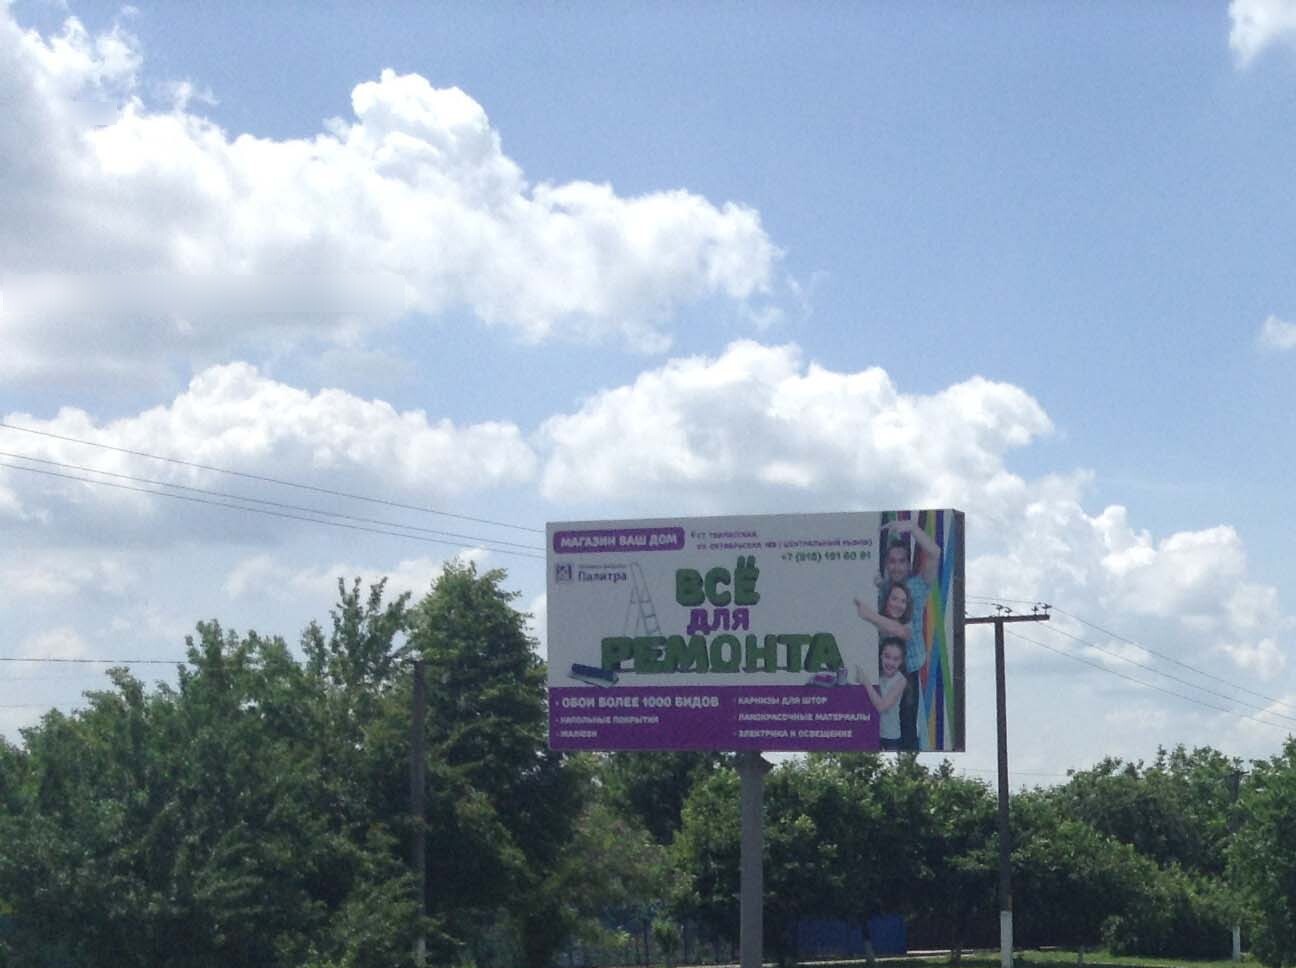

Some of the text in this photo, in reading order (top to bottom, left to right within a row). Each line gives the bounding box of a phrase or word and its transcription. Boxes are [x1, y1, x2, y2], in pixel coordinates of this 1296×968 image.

[560, 533, 679, 548] МАГАЗИН ВАШ ДОМ
[577, 570, 627, 584] Палитра
[675, 555, 761, 607] ВСЁ
[686, 607, 750, 636] ДЛЯ
[600, 632, 845, 675] РЕМОНТА
[561, 695, 720, 710] ОБОИ БОЛЕЕ 1000 ВИДОВ
[737, 695, 828, 706] КАРНИЗЫ ДЛЯ ШТОР
[815, 712, 871, 722] МАТЕРИАЛЫ
